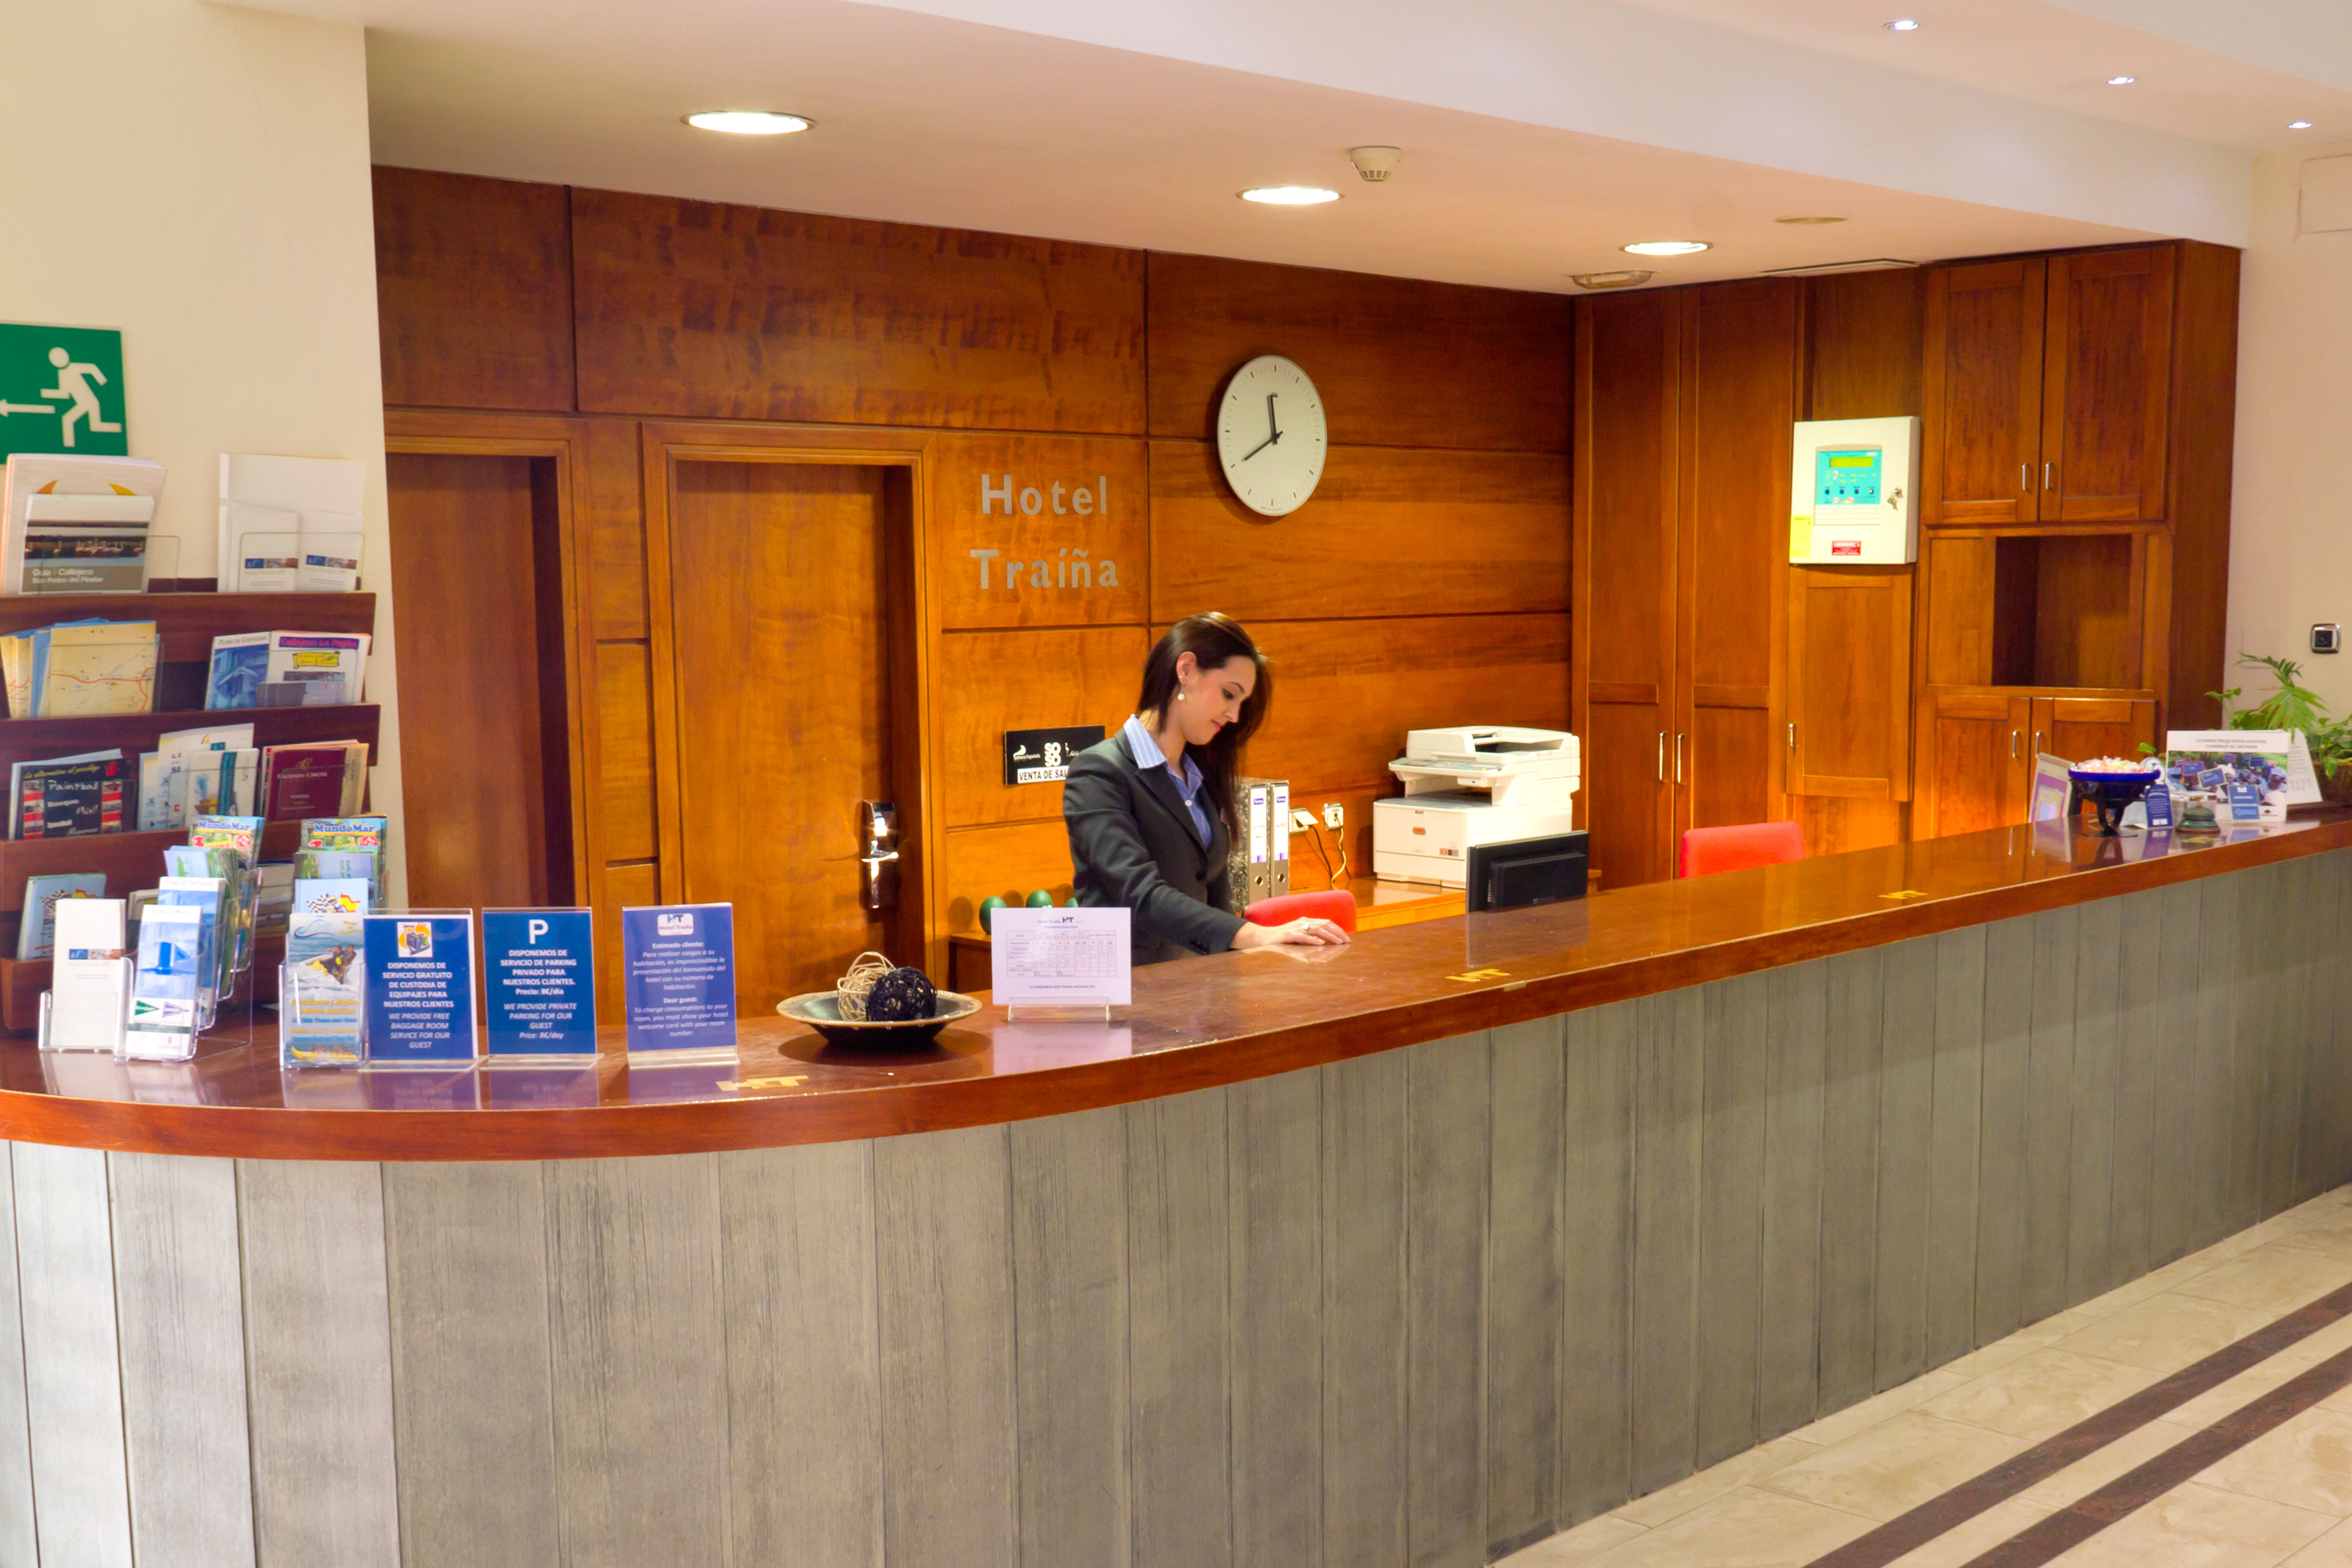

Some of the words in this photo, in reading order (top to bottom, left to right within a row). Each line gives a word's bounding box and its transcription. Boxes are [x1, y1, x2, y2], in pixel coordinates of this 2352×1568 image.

[982, 474, 1107, 515] Hotel
[59, 568, 94, 577] Callejero
[970, 547, 1119, 589] Traíña
[281, 637, 318, 647] Callejero
[320, 638, 329, 647] Lo
[1019, 771, 1042, 781] VENTA
[1044, 770, 1052, 779] DE
[198, 821, 251, 831] MundoMar
[314, 824, 375, 833] MundoMar
[529, 919, 549, 945] P
